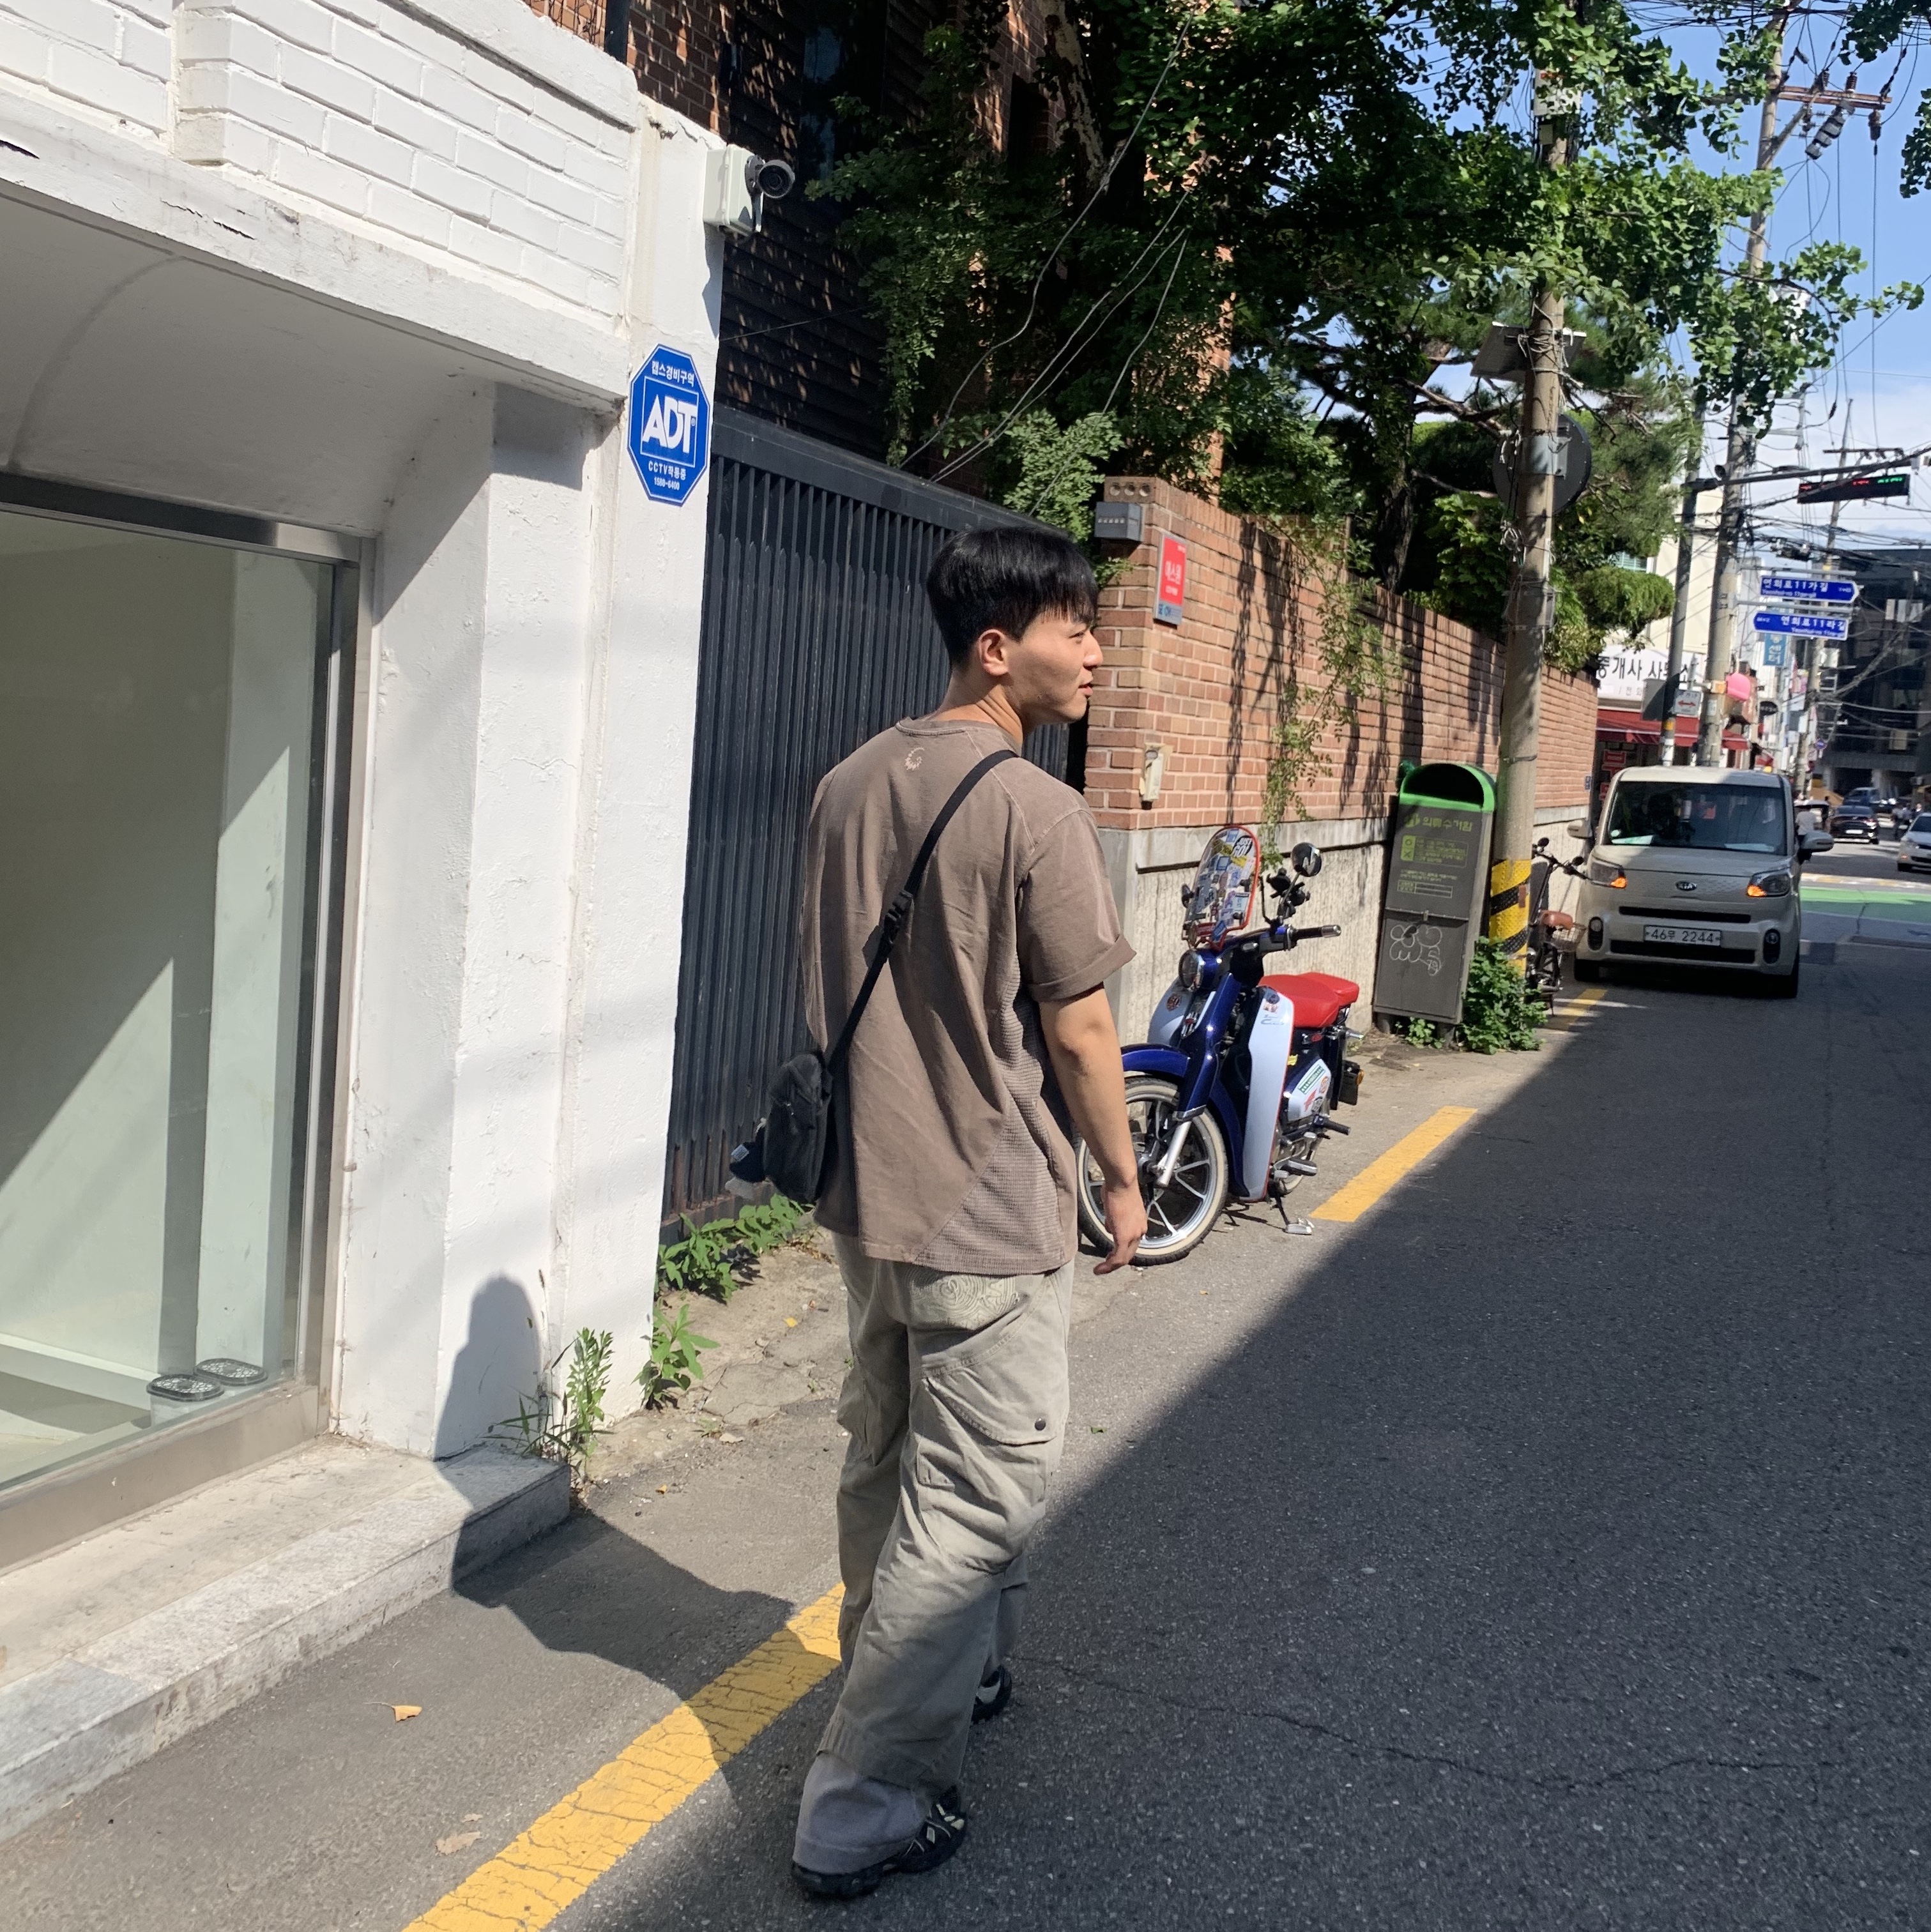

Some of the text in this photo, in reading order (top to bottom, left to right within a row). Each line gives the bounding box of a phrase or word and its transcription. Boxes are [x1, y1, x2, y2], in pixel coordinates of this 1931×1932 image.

[651, 360, 695, 387] 캡스경비구역
[643, 394, 697, 453] ADT
[1682, 931, 1714, 943] 2244
